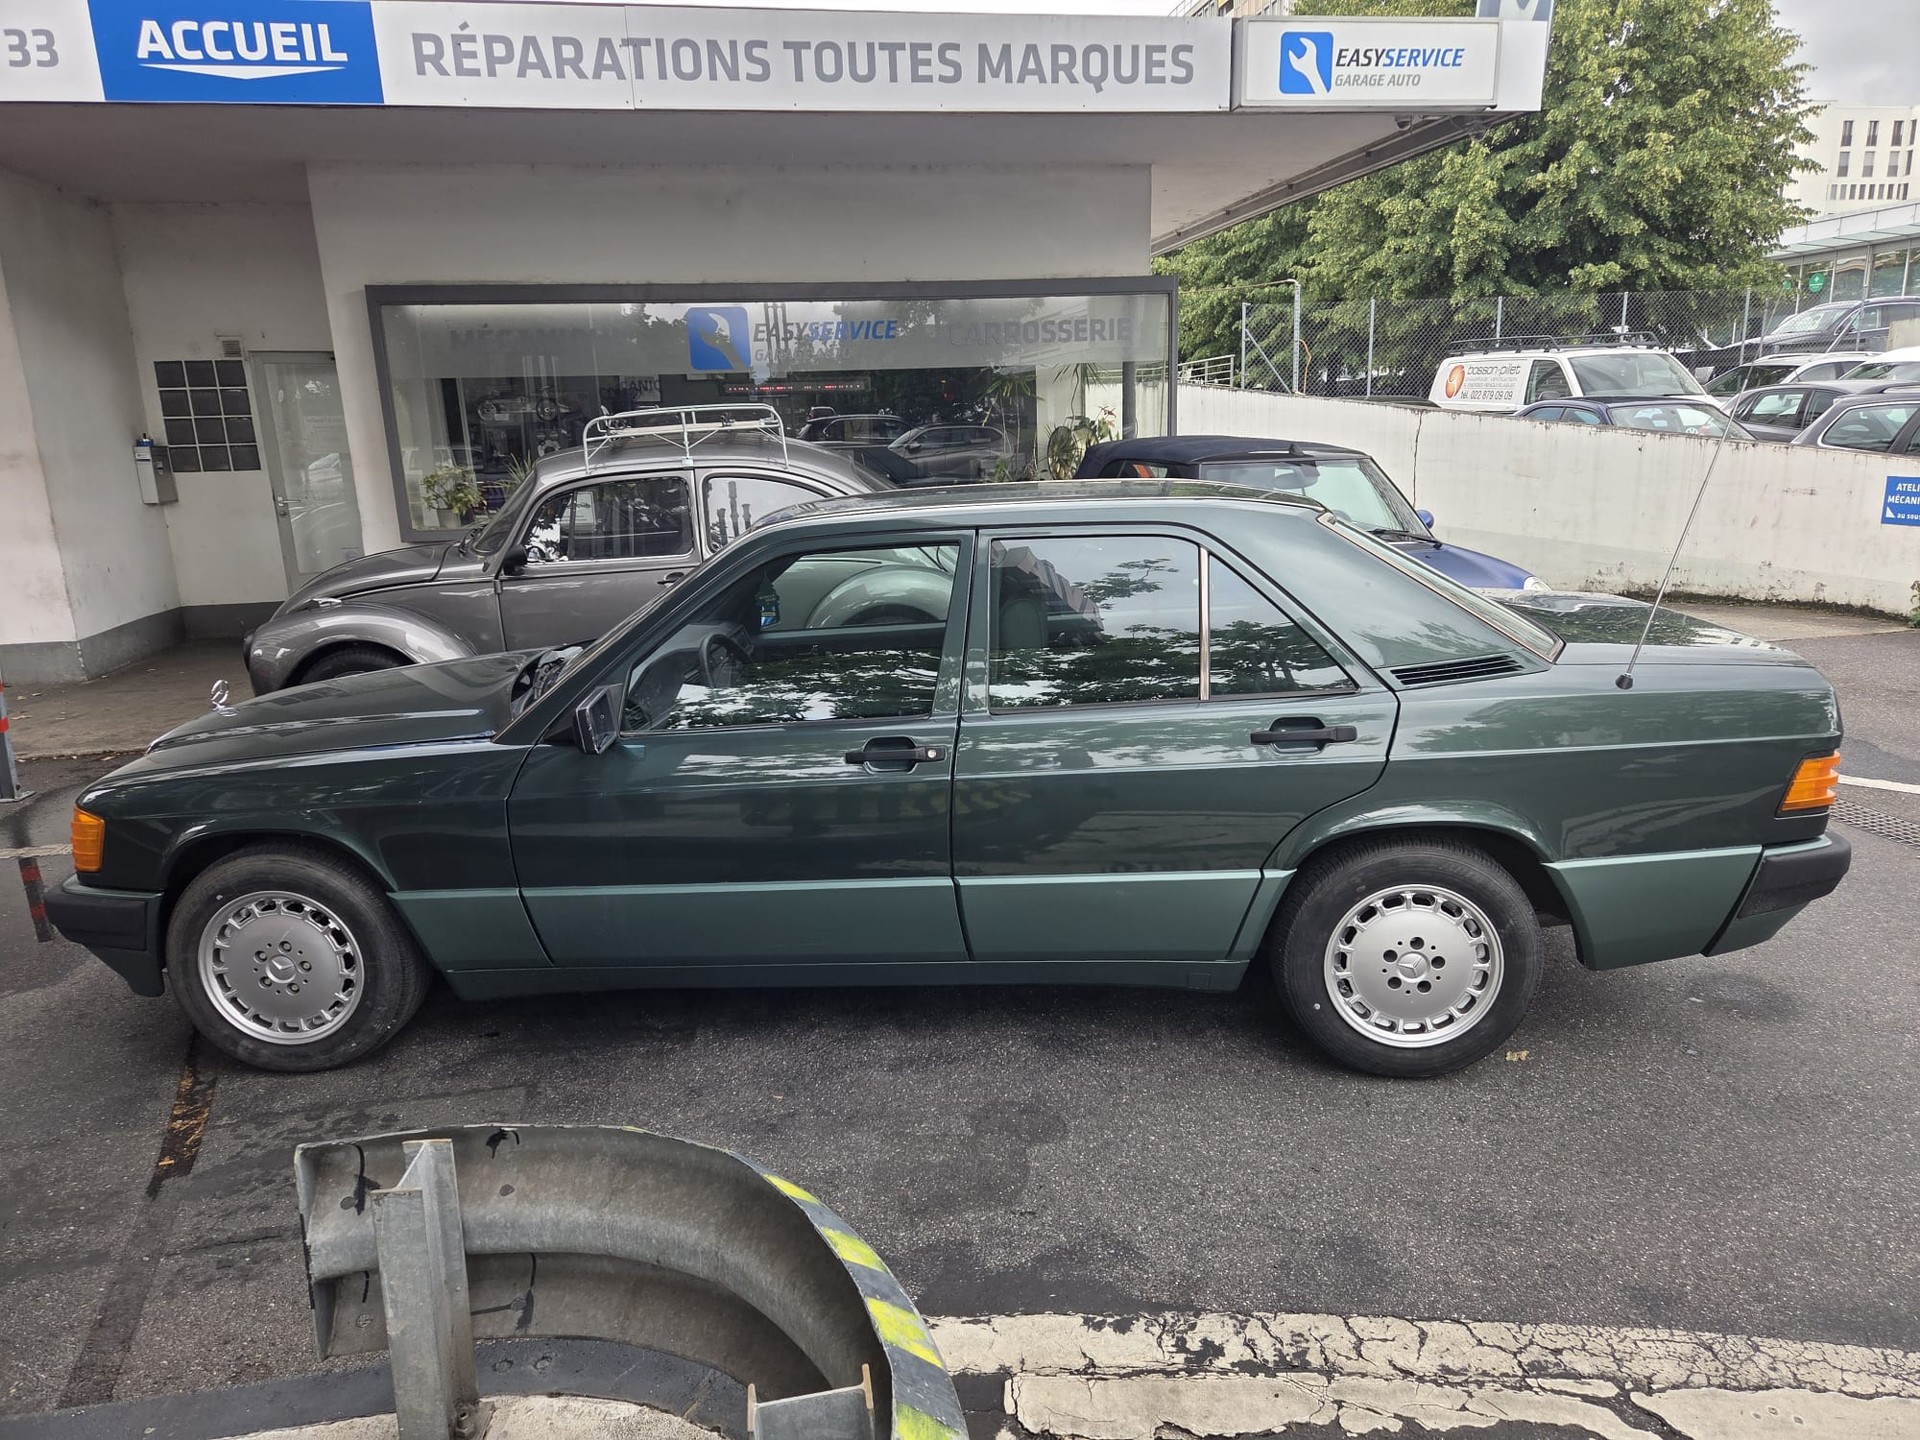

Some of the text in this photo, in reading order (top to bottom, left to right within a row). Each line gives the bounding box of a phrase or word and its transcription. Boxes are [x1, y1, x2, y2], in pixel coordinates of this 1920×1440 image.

[3, 28, 59, 67] 33
[136, 20, 348, 62] ACCUEIL
[411, 21, 1194, 93] RÉPARATIONS TOUTES MARQUES
[1335, 48, 1465, 67] EASYSERVICE
[1335, 74, 1421, 87] GARAGE AUTO
[753, 320, 898, 342] EASYSERVICE
